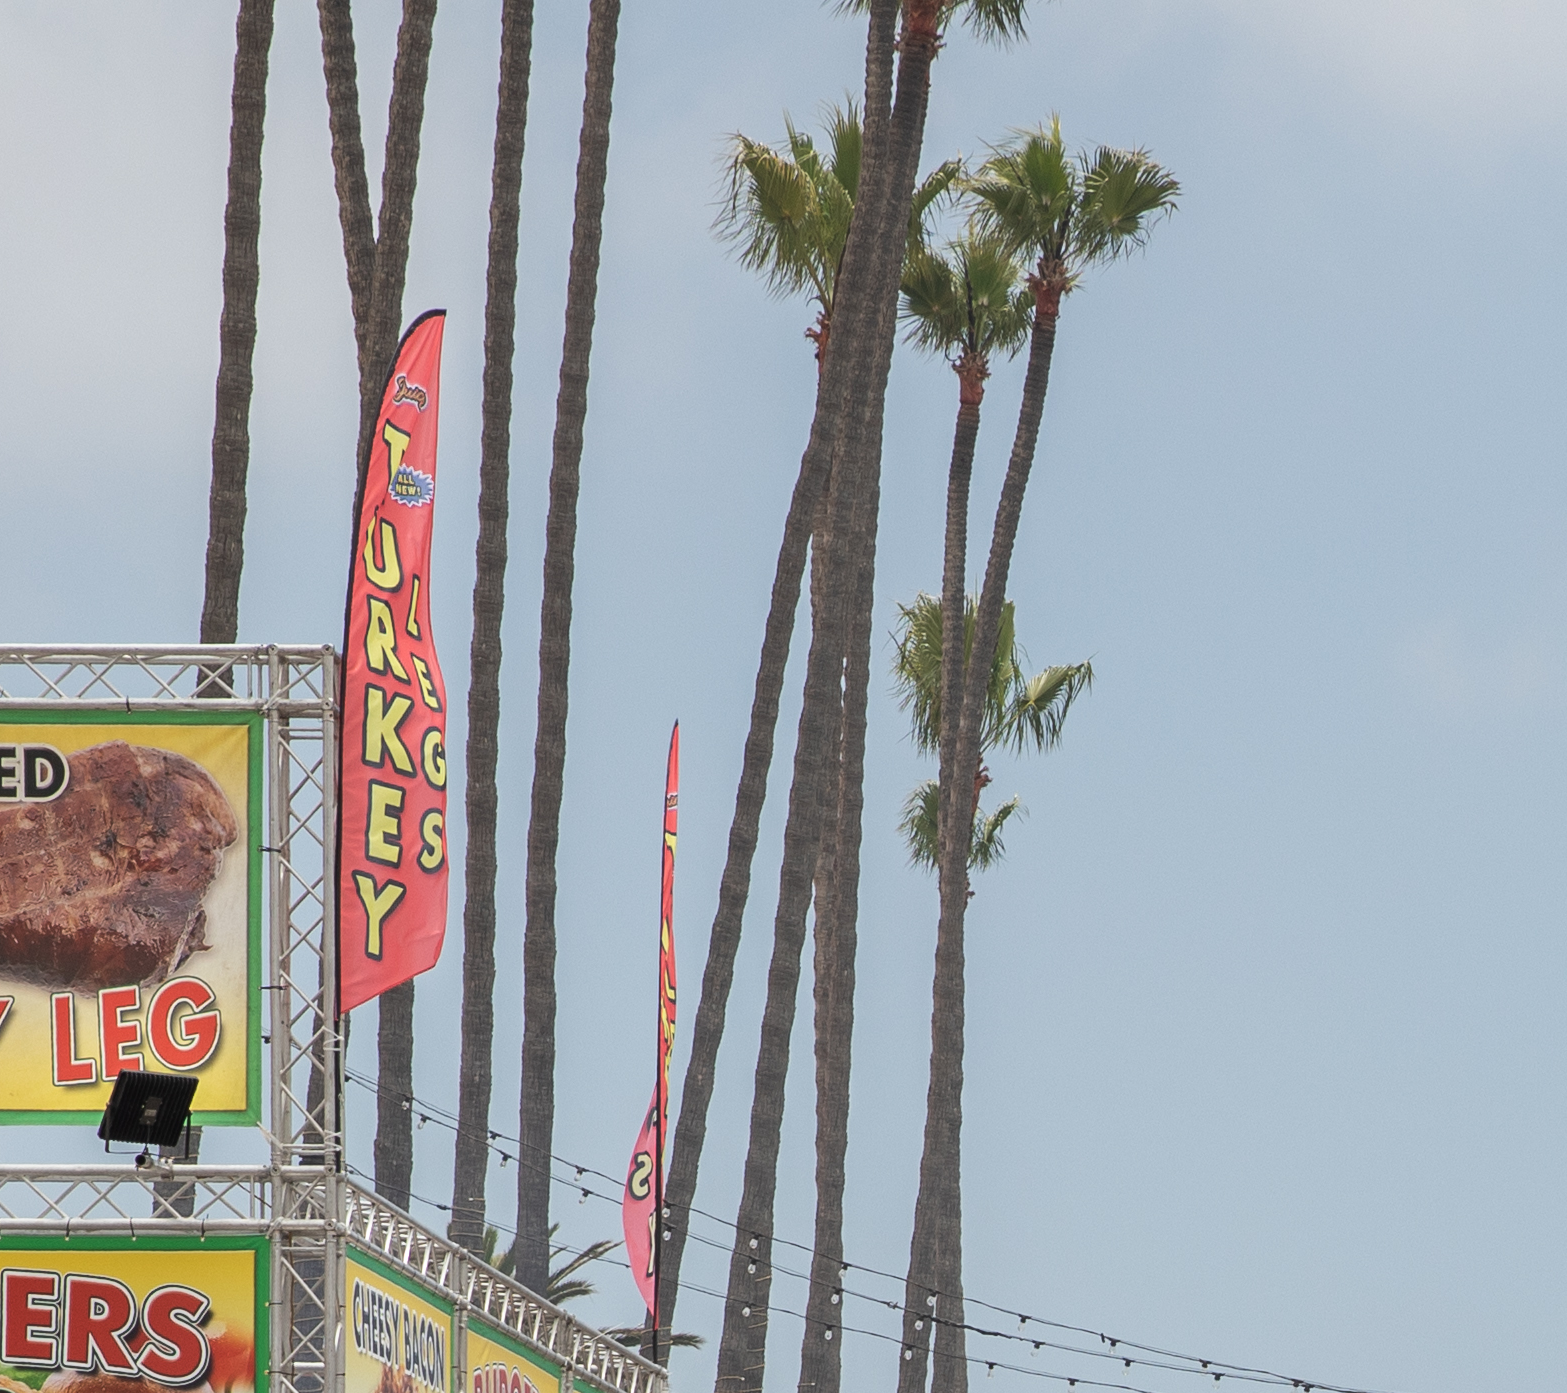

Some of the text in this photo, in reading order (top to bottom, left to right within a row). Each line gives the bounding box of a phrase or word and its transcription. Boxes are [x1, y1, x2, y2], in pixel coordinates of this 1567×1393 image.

[394, 484, 423, 498] NEW!
[396, 473, 415, 486] ALL
[49, 976, 222, 1087] LEG
[353, 1277, 400, 1369] CHEESY
